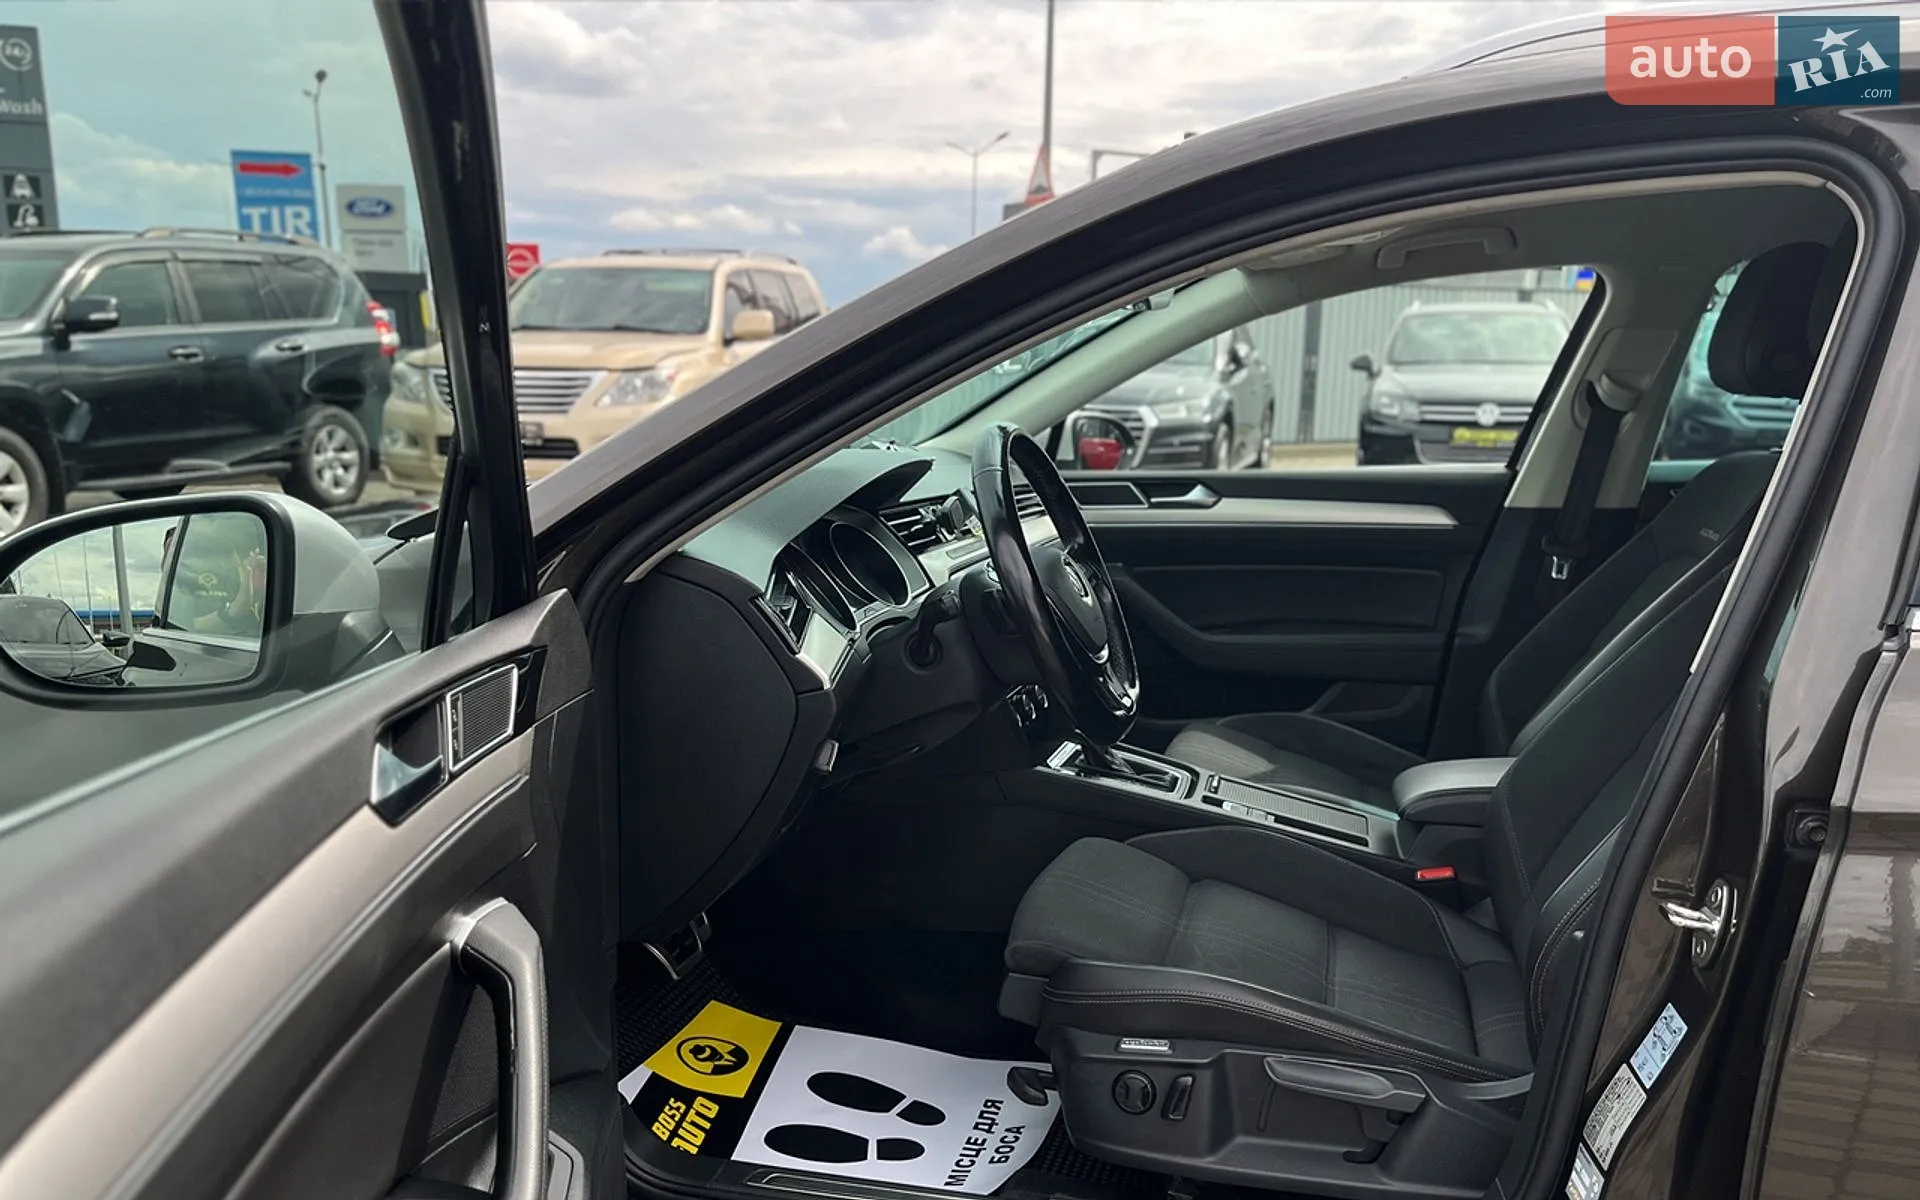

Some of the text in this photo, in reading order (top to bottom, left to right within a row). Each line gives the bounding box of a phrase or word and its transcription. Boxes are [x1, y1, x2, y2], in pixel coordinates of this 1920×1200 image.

[241, 205, 314, 236] TIR
[651, 1097, 687, 1141] BOSS
[943, 1098, 1005, 1186] МІСЦЕ ДЛЯ
[988, 1125, 1026, 1164] БОСА
